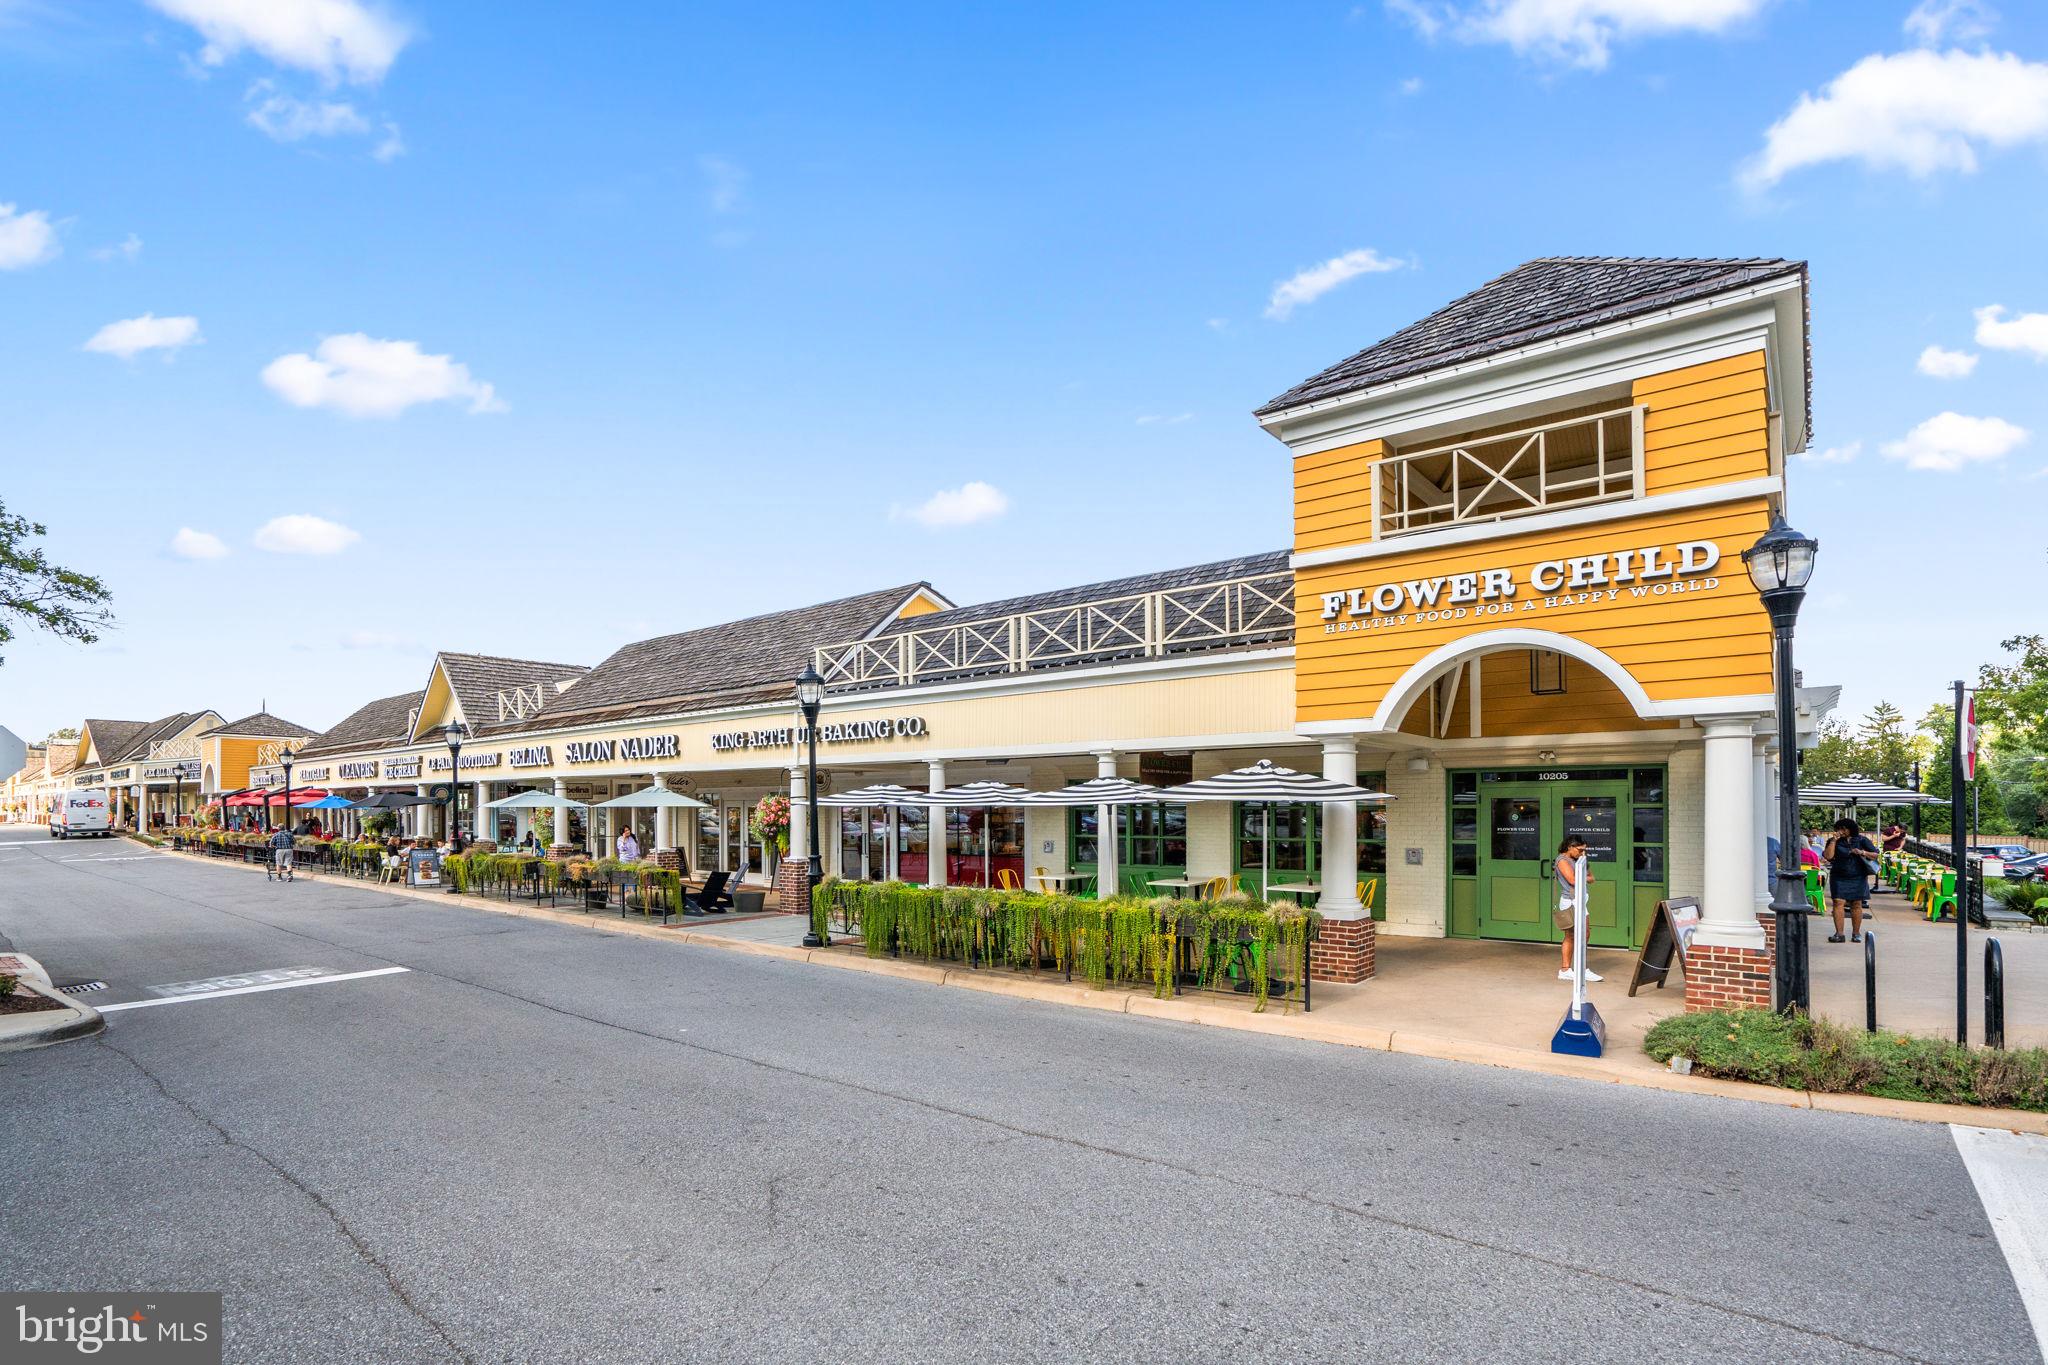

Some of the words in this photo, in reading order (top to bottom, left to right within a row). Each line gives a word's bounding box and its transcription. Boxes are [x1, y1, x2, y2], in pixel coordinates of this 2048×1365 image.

[1321, 568, 1516, 620] FLOWER
[1530, 540, 1720, 593] CHILD
[1325, 613, 1409, 634] HEALTHY
[1415, 607, 1466, 624] FOOD
[1474, 603, 1513, 618] FOR
[1523, 599, 1536, 611] A
[1544, 588, 1620, 608] HAPPY
[1630, 577, 1721, 596] WORLD
[711, 732, 744, 750] KING
[822, 719, 890, 743] BAKING
[894, 716, 926, 736] CO.
[509, 746, 552, 767] BELINA
[565, 740, 613, 763] SALON
[620, 734, 677, 759] NADER
[567, 785, 589, 793] belina
[1538, 772, 1569, 781] 10205
[70, 799, 104, 808] FedEx
